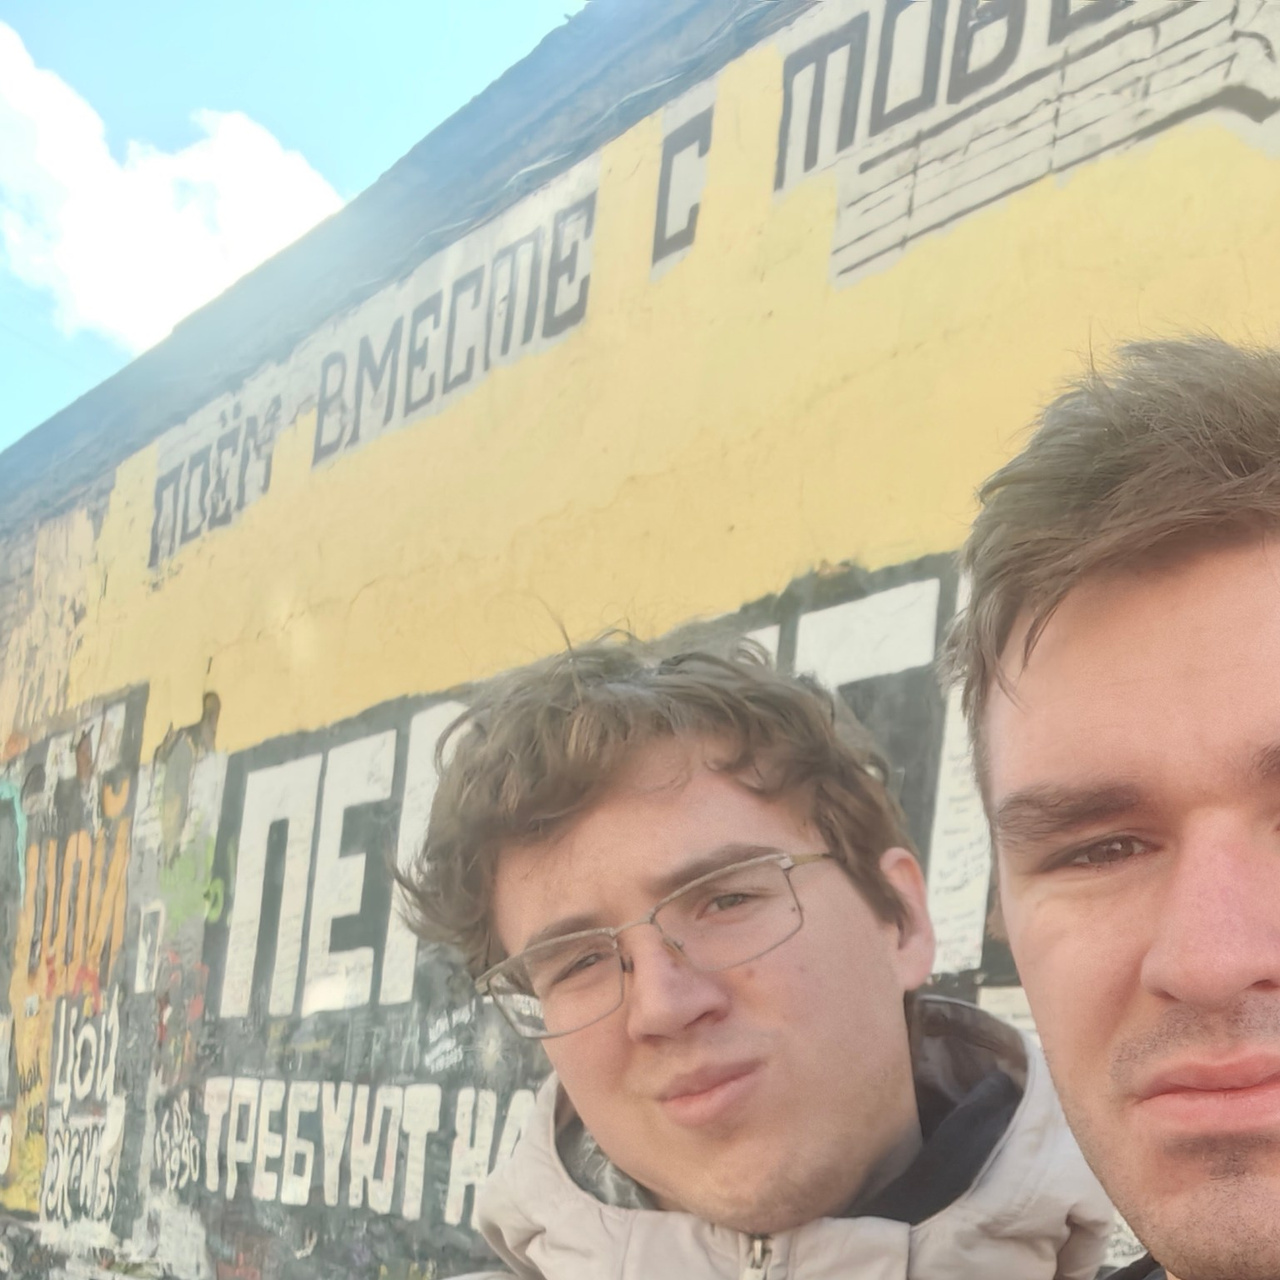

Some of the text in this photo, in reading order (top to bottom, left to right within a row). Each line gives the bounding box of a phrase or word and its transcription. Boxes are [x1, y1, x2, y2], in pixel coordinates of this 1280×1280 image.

[312, 190, 598, 470] ВМЕСТЕ
[652, 103, 715, 266] С
[203, 1076, 442, 1221] ТРЕБУЮТ
